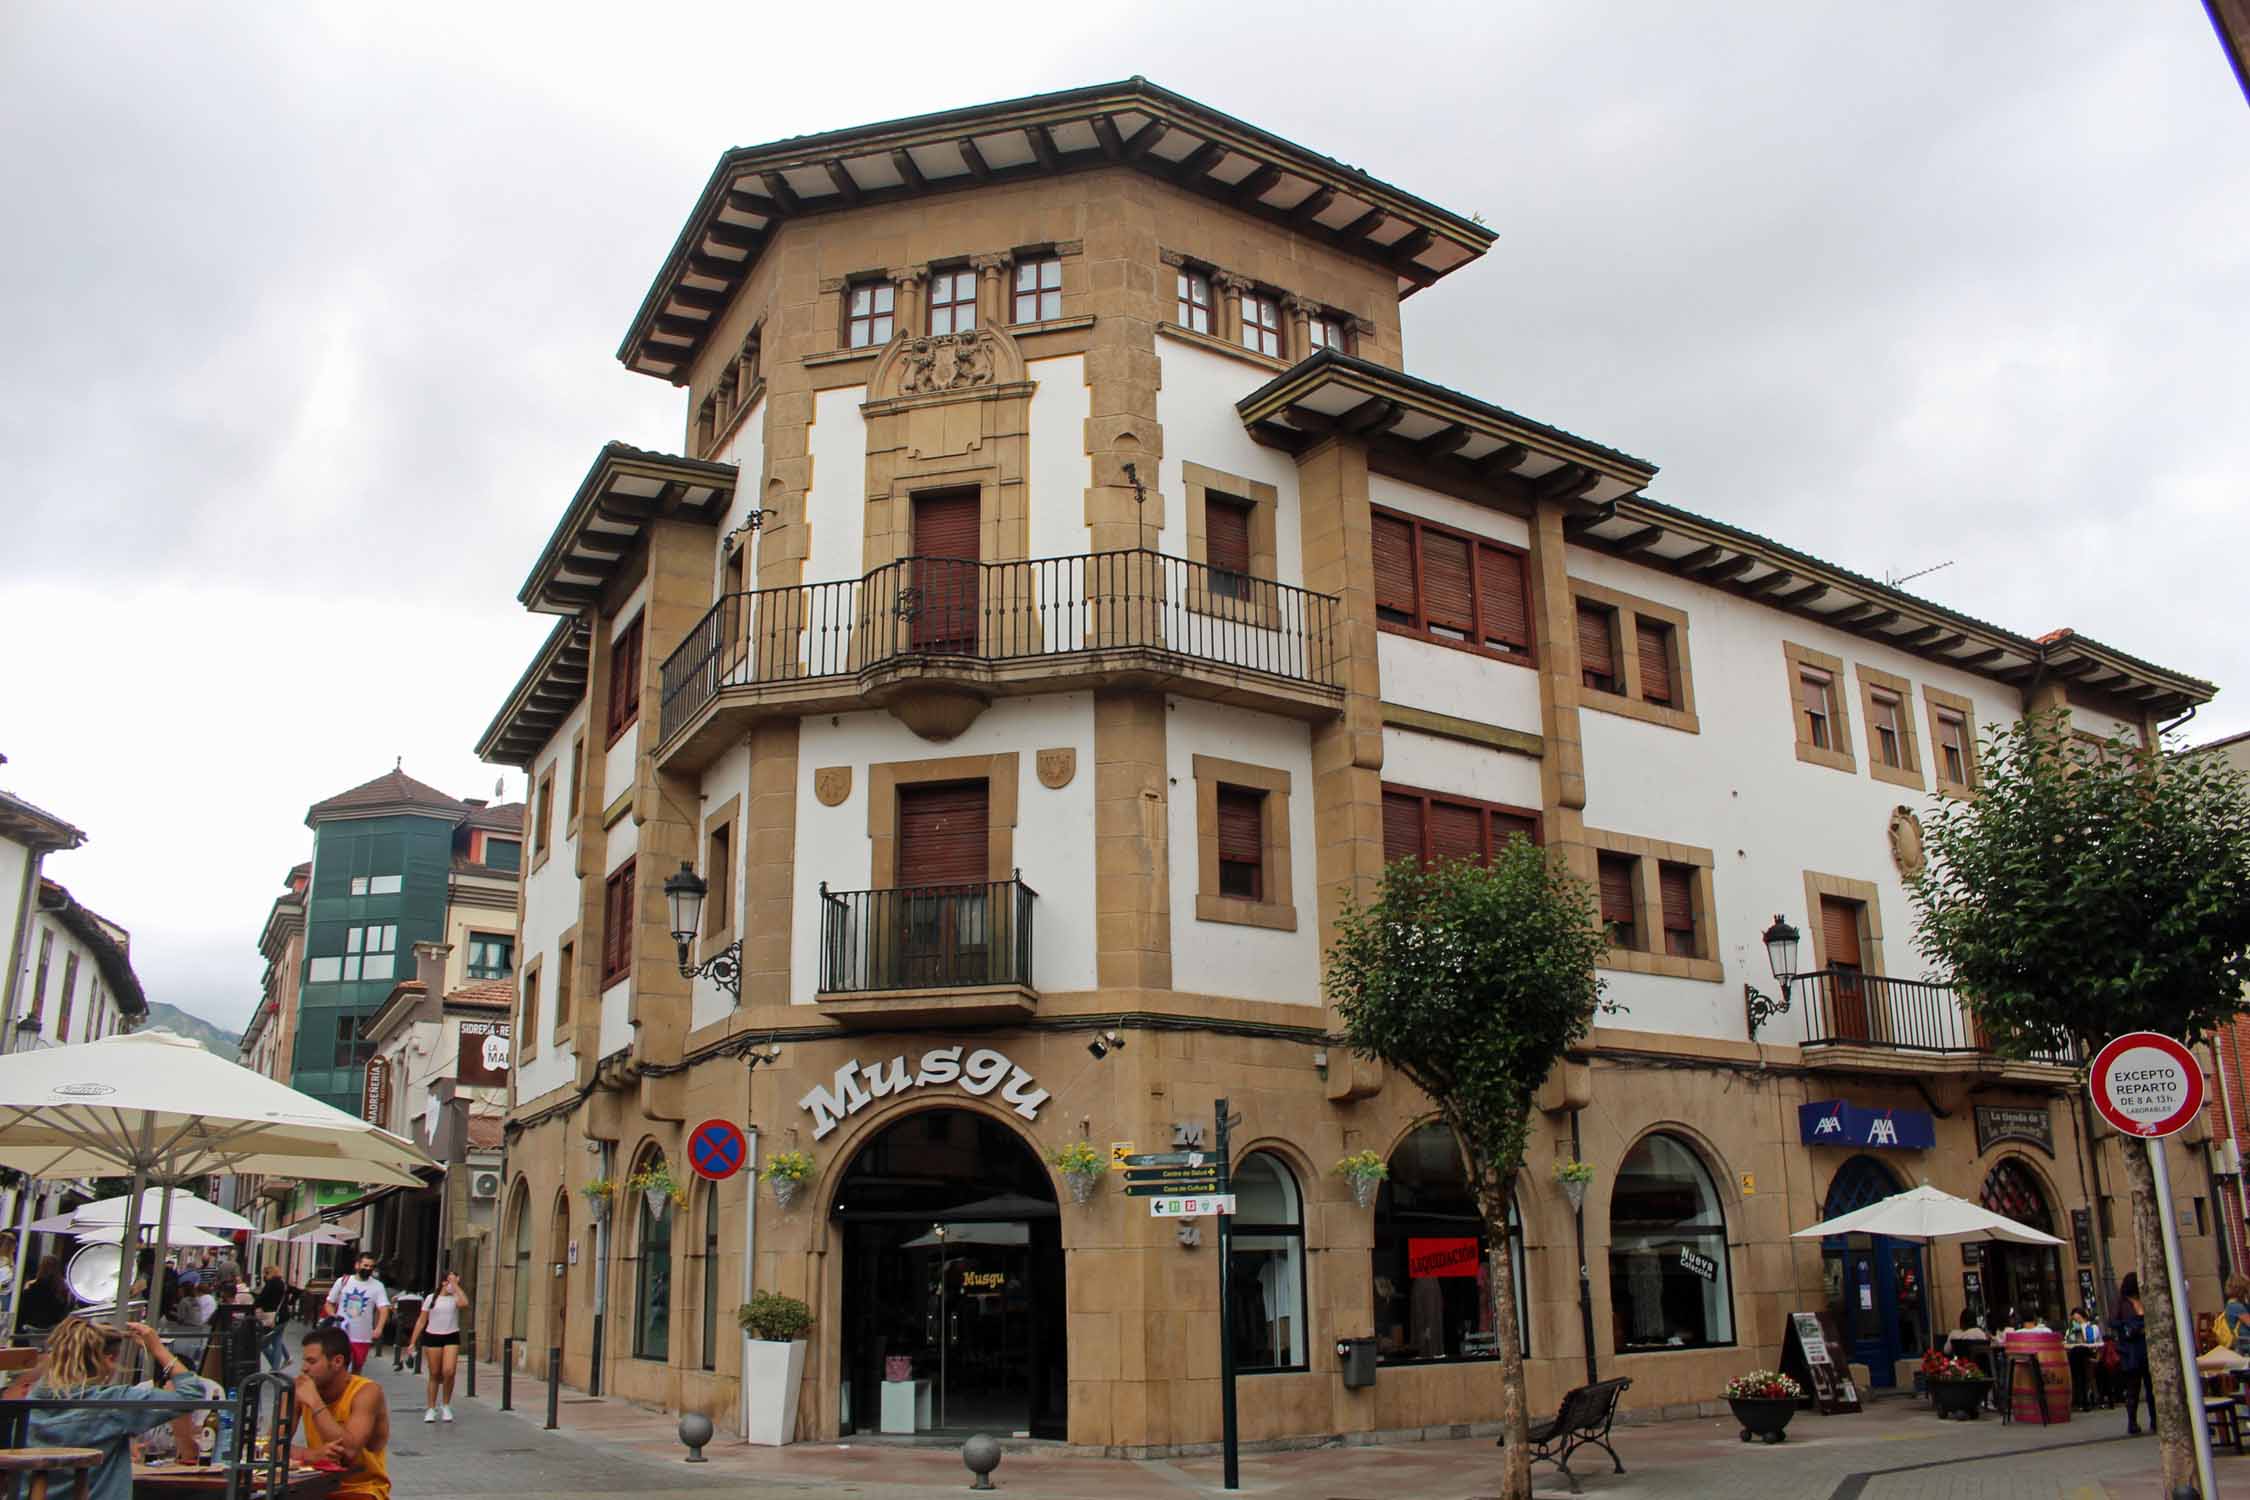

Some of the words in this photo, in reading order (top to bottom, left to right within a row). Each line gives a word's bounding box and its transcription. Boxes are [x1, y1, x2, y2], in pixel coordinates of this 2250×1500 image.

[2115, 1068, 2175, 1082] EXCEPTO
[799, 1046, 1051, 1141] Musgu
[2116, 1081, 2177, 1095] REPARTO
[2120, 1096, 2134, 1106] DE
[2137, 1096, 2143, 1105] 8
[2145, 1096, 2153, 1105] A
[1814, 1117, 1841, 1135] AXA
[1867, 1119, 1898, 1144] AXA
[1681, 1246, 1713, 1271] Nueva
[962, 1271, 1005, 1289] Musgu
